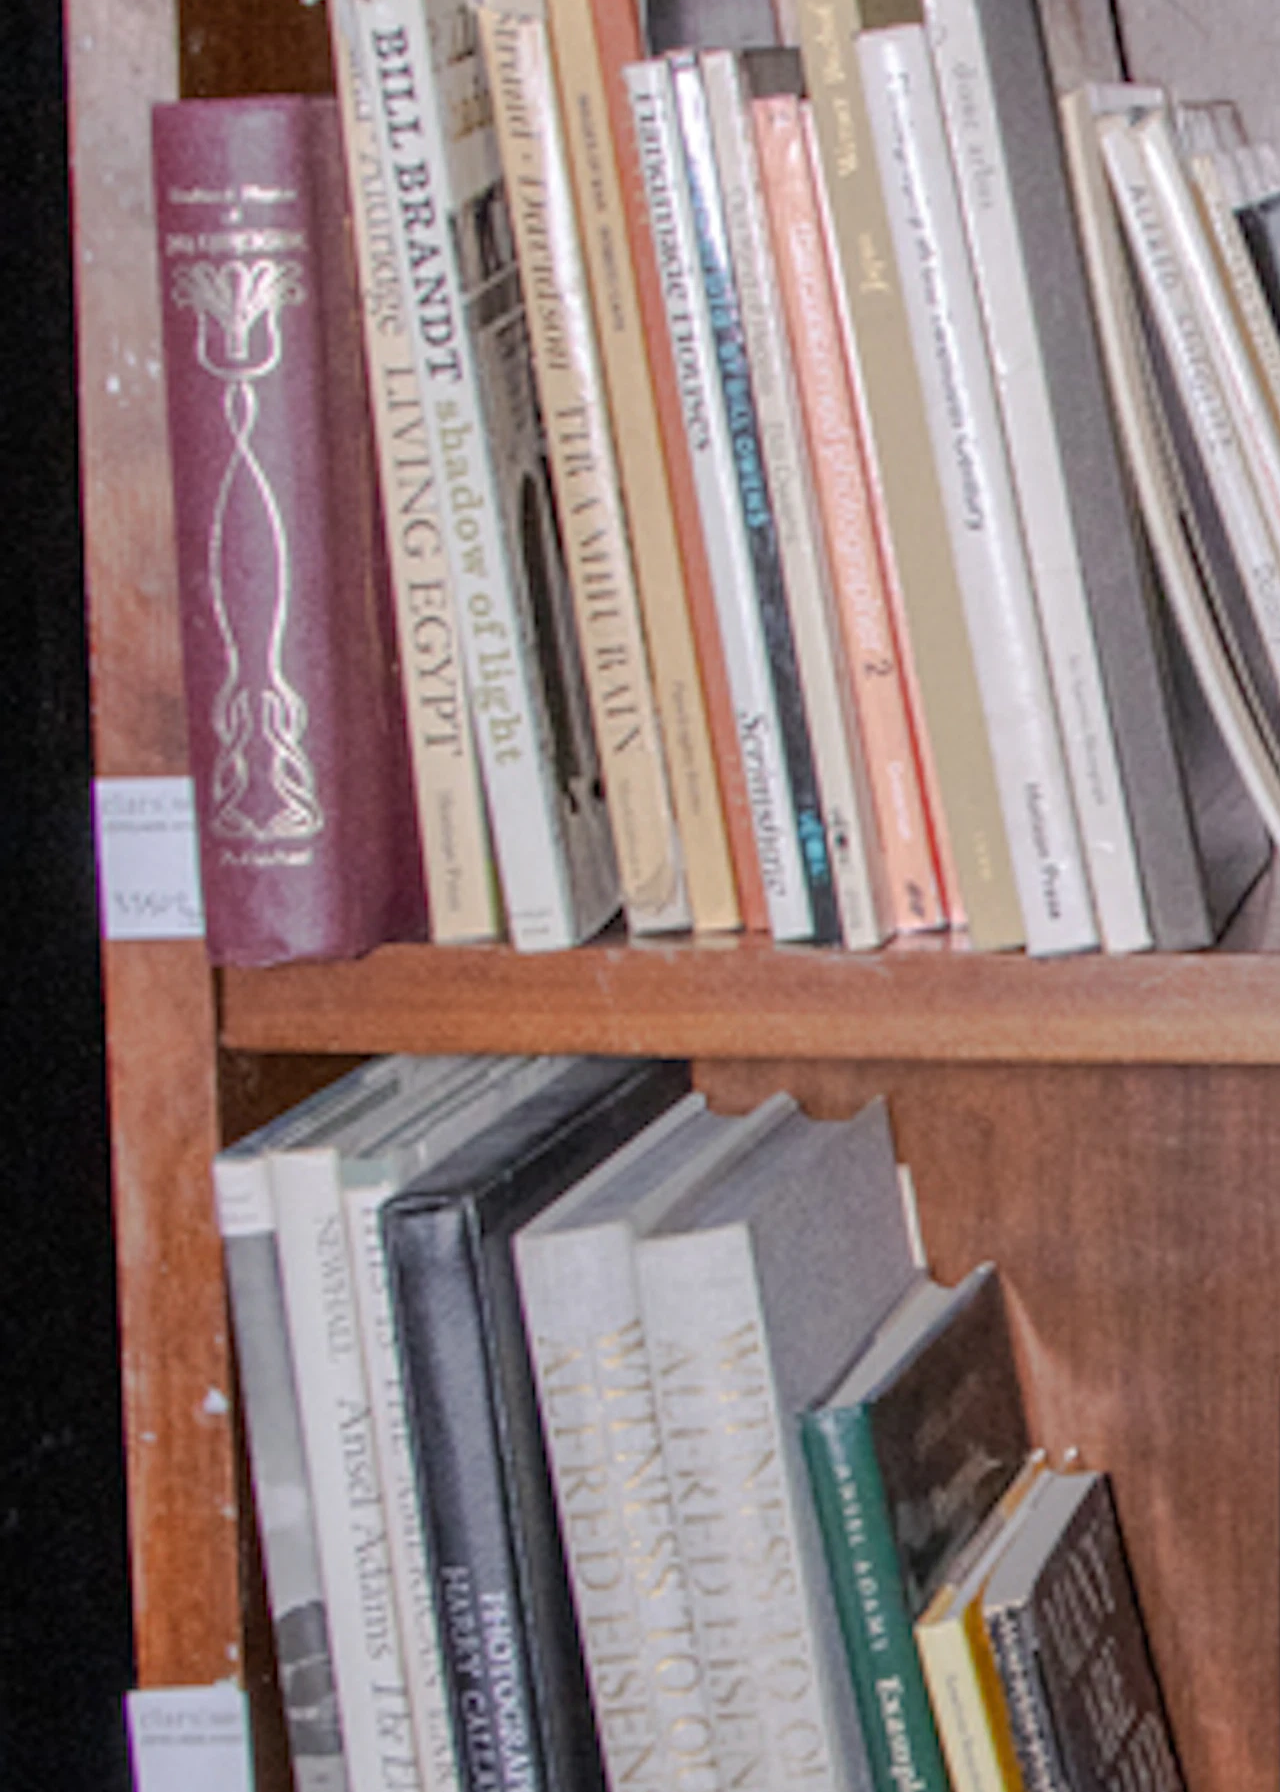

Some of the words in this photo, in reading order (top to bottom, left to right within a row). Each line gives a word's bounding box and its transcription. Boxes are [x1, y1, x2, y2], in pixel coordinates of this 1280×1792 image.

[370, 22, 426, 151] BILL
[392, 160, 465, 389] BRANDT
[375, 359, 444, 559] LIVING
[432, 395, 501, 580] shadow
[729, 432, 767, 530] OWENS
[945, 431, 990, 534] Century
[398, 575, 467, 762] EGYPT
[464, 589, 511, 642] of
[862, 655, 894, 679] 2
[467, 643, 532, 768] light
[312, 1211, 361, 1364] NEWHALL
[333, 1394, 384, 1511] Ansel
[529, 1326, 628, 1602] ALFRED
[586, 1316, 691, 1602] WITNESS
[641, 1608, 709, 1702] TO
[643, 1333, 735, 1605] ALFRED
[704, 1318, 806, 1601] WITNESS
[755, 1609, 822, 1705] TO
[346, 1518, 404, 1663] Adams
[439, 1562, 485, 1677] HARRY
[848, 1557, 894, 1654] ADAMS
[366, 1672, 413, 1746] The
